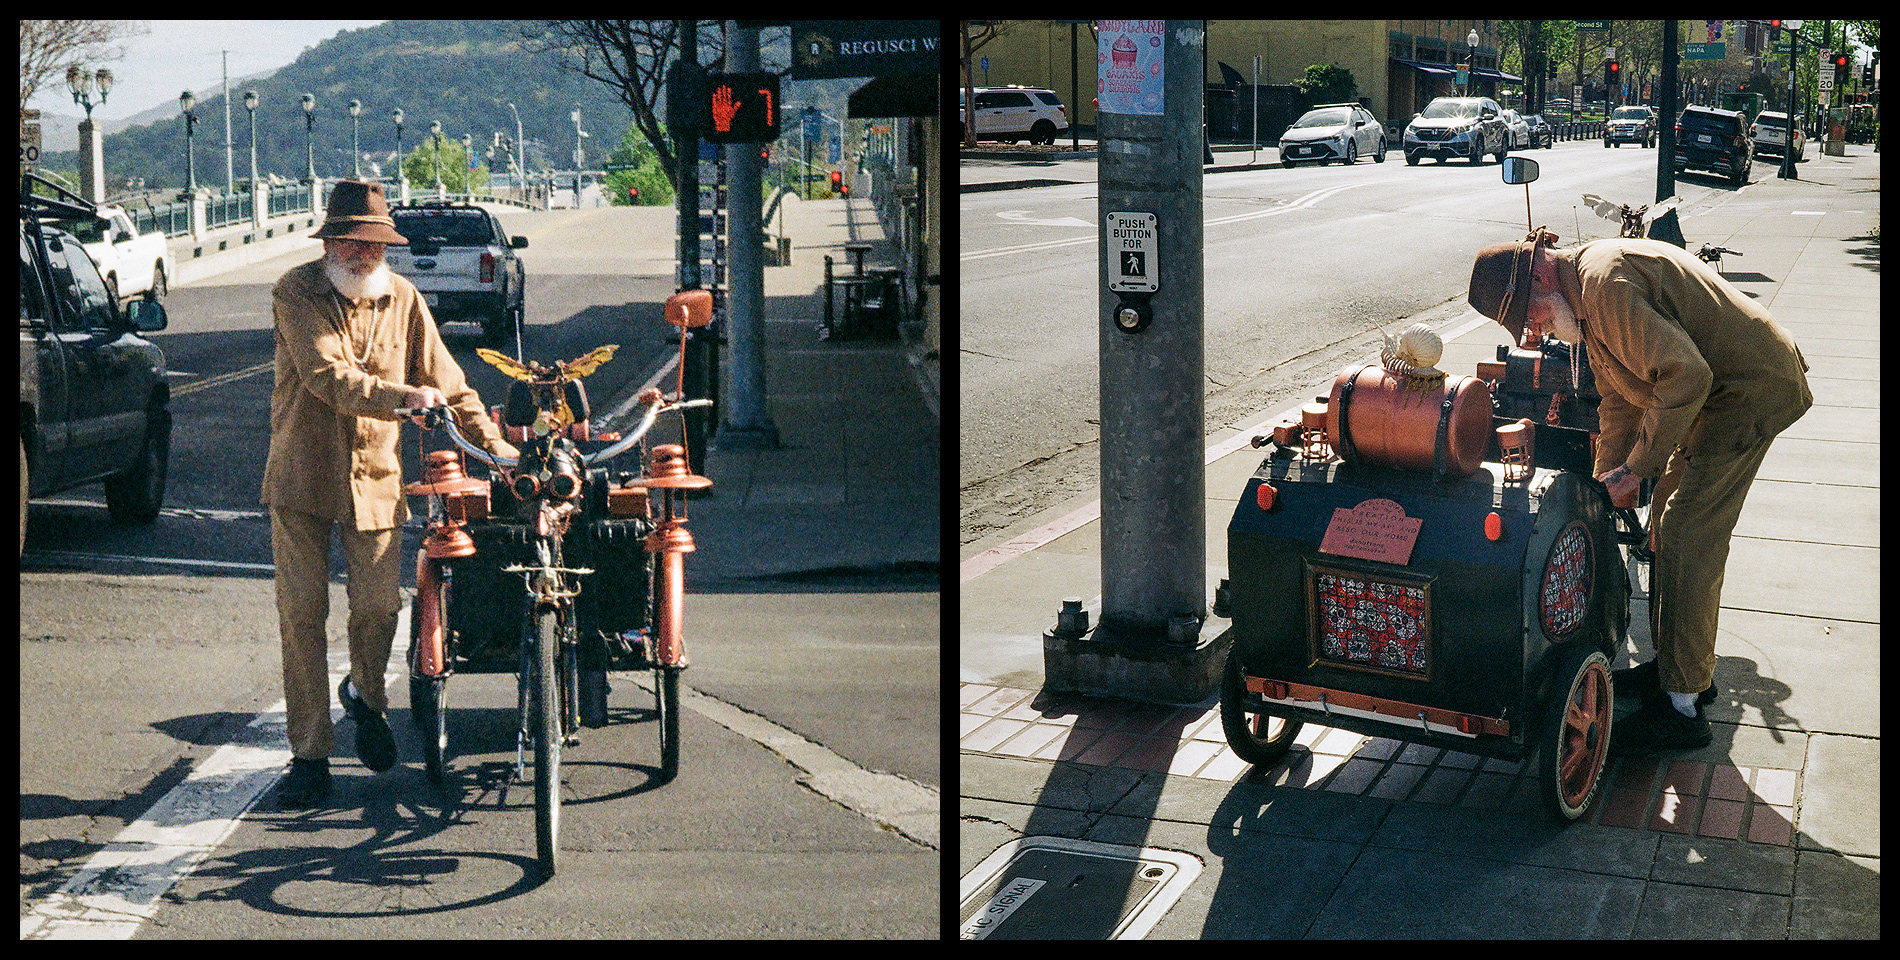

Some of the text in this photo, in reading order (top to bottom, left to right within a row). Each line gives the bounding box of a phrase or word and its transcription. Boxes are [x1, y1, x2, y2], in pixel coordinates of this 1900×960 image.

[840, 39, 917, 55] REGUSCI
[1820, 80, 1832, 88] 20
[1119, 219, 1145, 229] PUSH
[1113, 229, 1151, 239] BUTTON
[1123, 239, 1142, 249] FOR
[989, 882, 1036, 914] SIGNAL
